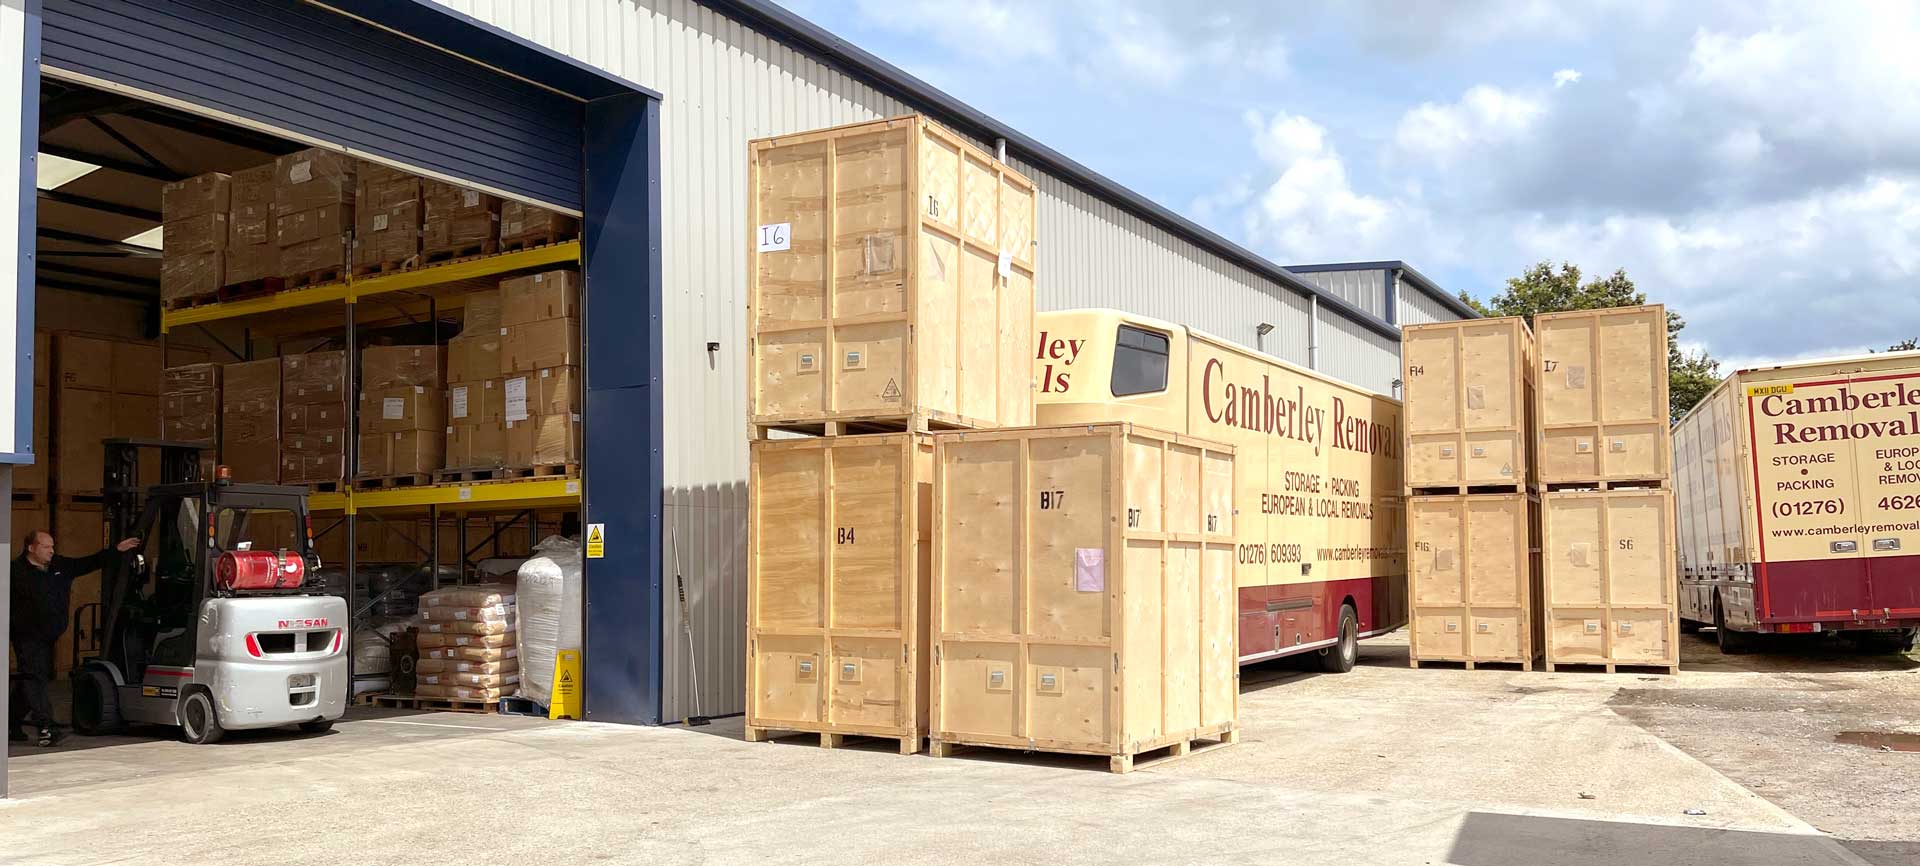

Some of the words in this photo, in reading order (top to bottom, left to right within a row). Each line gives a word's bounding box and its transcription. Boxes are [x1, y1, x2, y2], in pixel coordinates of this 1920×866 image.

[761, 226, 784, 246] I6
[1036, 331, 1086, 366] ley
[1410, 366, 1424, 376] F14
[1544, 360, 1559, 372] I7
[1040, 364, 1071, 394] ls
[1203, 358, 1325, 457] Camberley
[1774, 411, 1920, 445] Removal
[1772, 453, 1835, 466] STORAGE
[1876, 447, 1919, 459] EUROP
[1884, 462, 1893, 471] &
[1285, 471, 1320, 494] STORAGE
[1331, 477, 1360, 498] PACKING
[1777, 479, 1835, 491] PACKING
[1041, 491, 1064, 509] B17
[1262, 494, 1306, 516] EUROPEAN
[1308, 501, 1313, 516] &
[1316, 500, 1340, 518] LOCAL
[1341, 501, 1373, 520] REMOVALS
[1772, 497, 1845, 519] (01276)
[1128, 508, 1140, 528] B17
[838, 527, 855, 544] B4
[1772, 520, 1920, 537] www.camberleyremoval
[1239, 542, 1267, 566] 01276)
[1271, 544, 1301, 563] 609393
